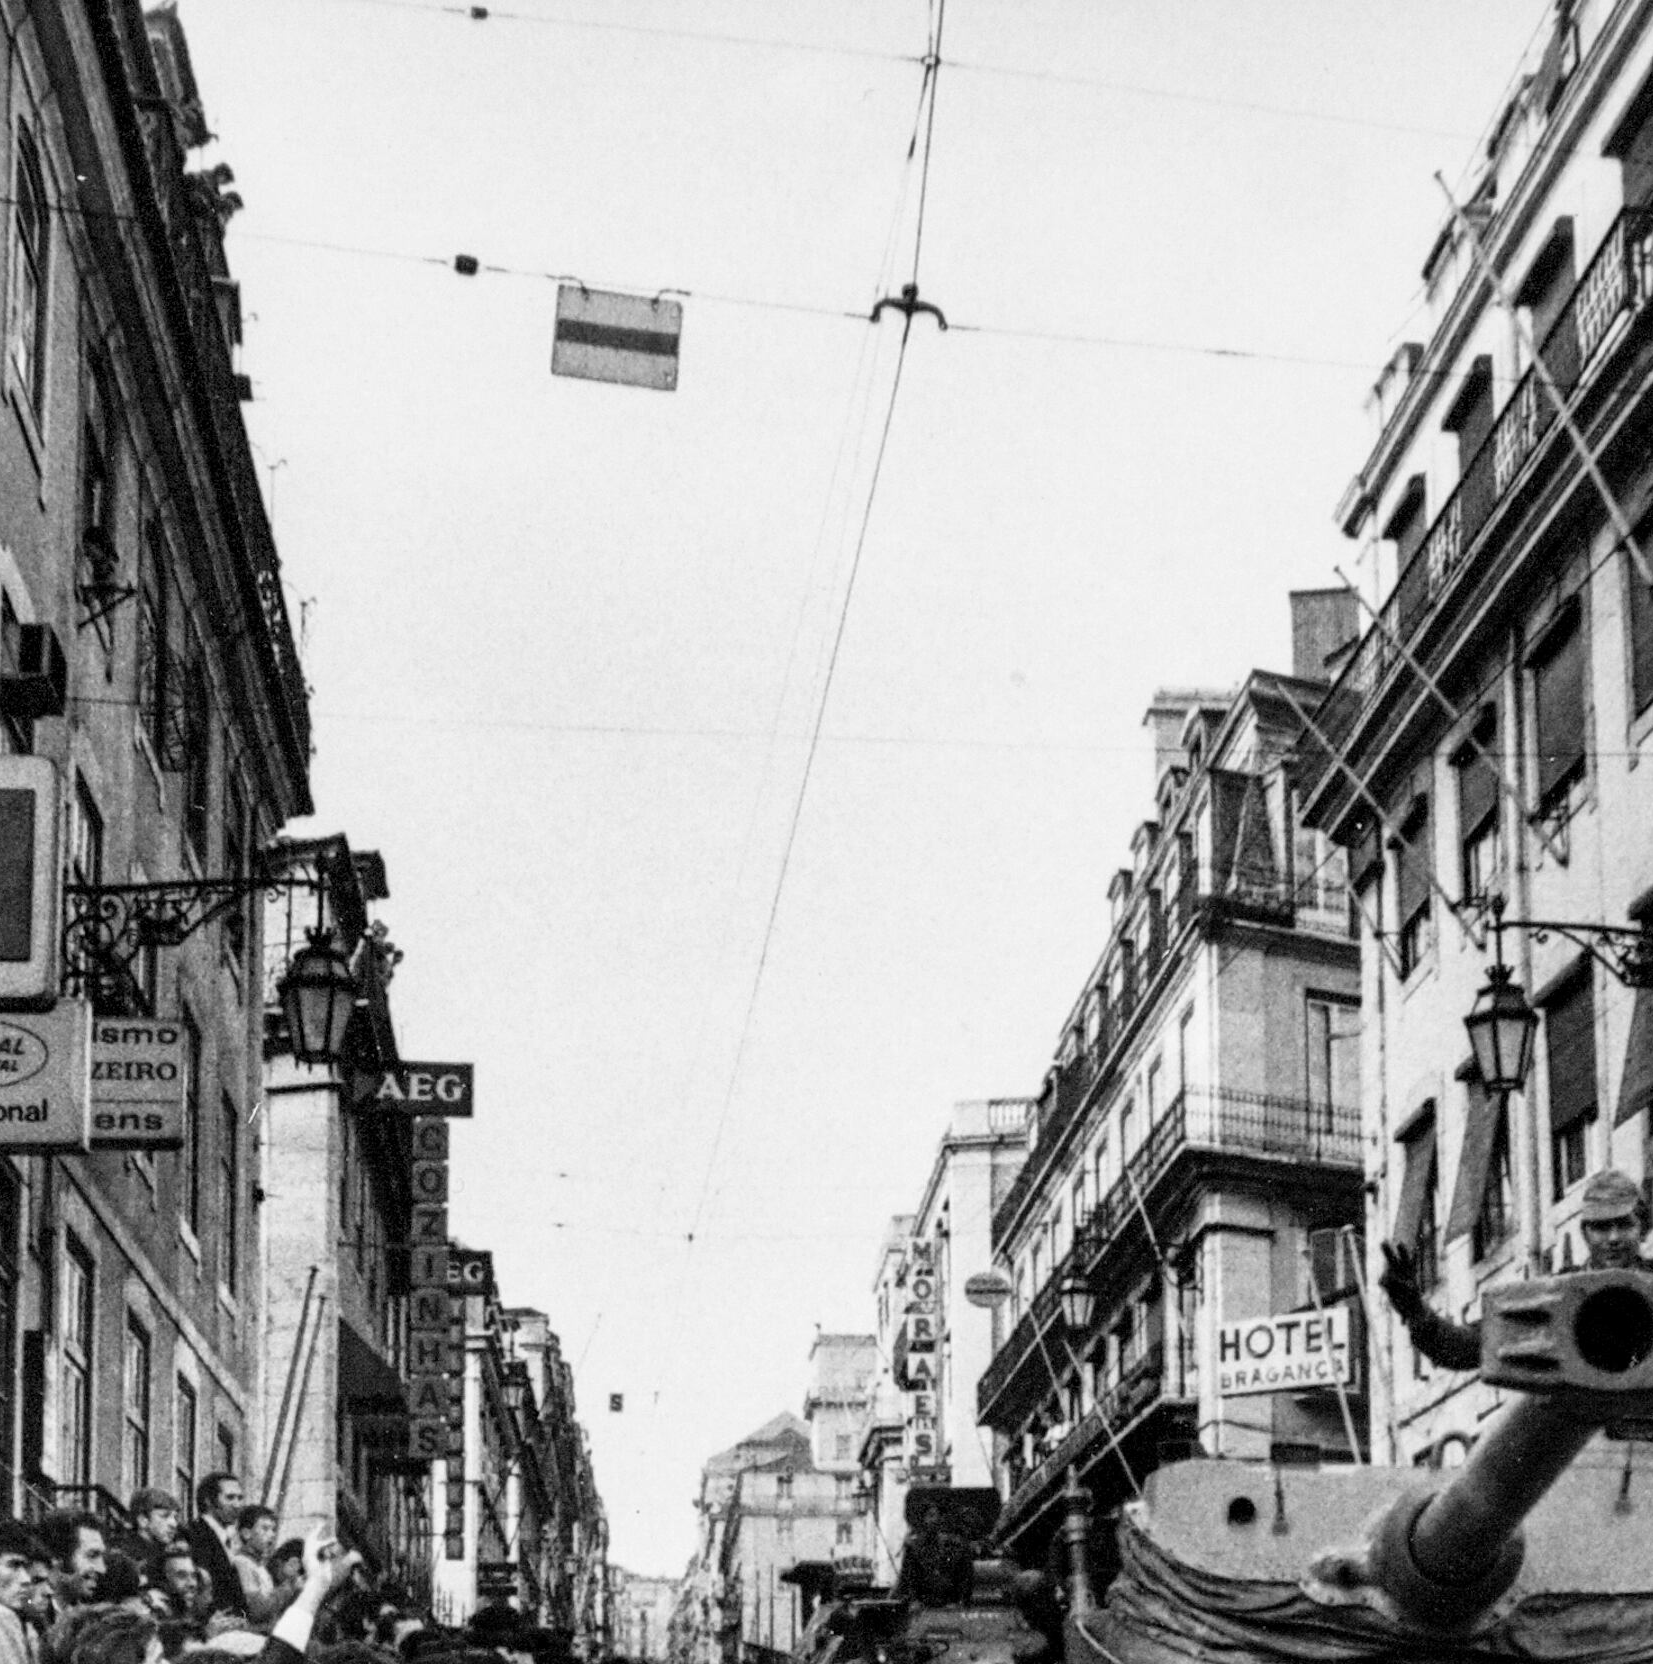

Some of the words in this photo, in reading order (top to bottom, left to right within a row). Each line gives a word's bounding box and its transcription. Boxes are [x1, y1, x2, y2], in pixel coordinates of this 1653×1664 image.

[376, 1072, 463, 1102] AEG
[1220, 1316, 1346, 1363] HOTEL
[1220, 1356, 1345, 1390] BRAGANÇA
